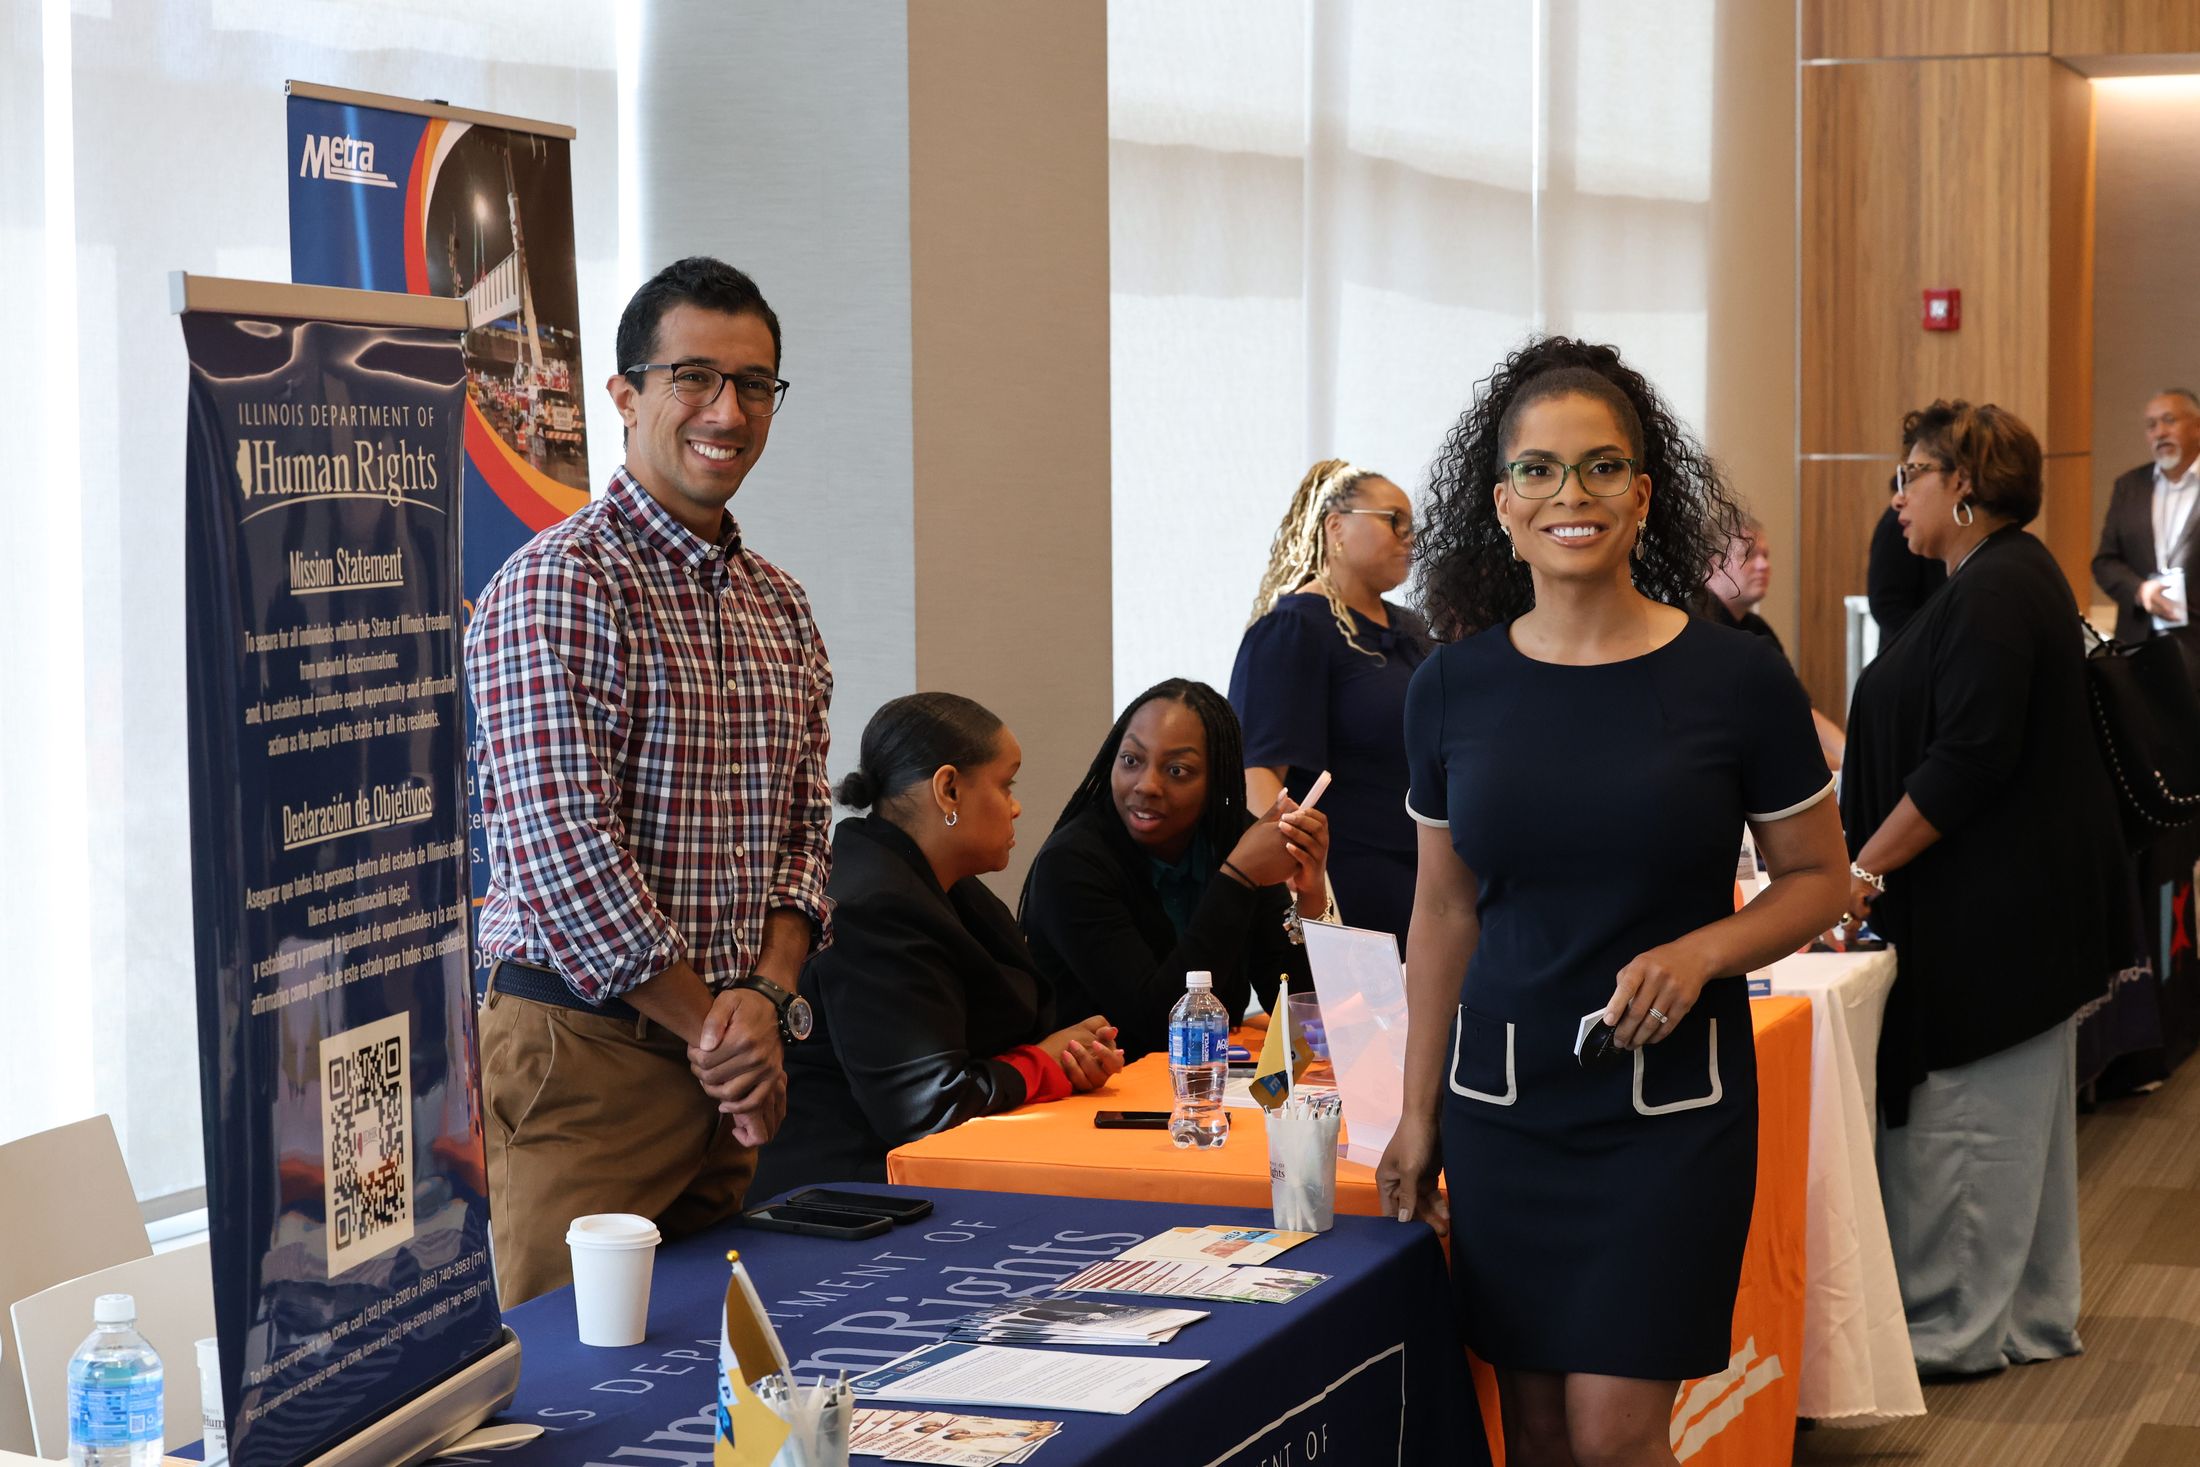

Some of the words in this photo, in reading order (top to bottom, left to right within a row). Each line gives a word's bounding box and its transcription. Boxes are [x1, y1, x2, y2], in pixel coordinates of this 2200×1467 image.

[300, 133, 375, 179] Metra
[238, 402, 304, 426] ILLINOIS
[311, 404, 410, 427] DEPARTMENT
[417, 406, 435, 428] OF
[252, 440, 353, 495] Human
[354, 439, 438, 507] Rights
[289, 550, 334, 589] Mission
[336, 546, 403, 585] Statement
[244, 631, 255, 653] To
[255, 633, 279, 652] secure
[279, 627, 289, 648] for
[290, 625, 299, 648] all
[299, 621, 335, 646] individuals
[335, 619, 357, 641] within
[358, 619, 370, 639] the
[371, 617, 392, 638] State
[392, 615, 400, 635] of
[401, 613, 425, 634] Illinois
[425, 611, 451, 631] freedom
[299, 660, 316, 680] from
[316, 654, 346, 679] unlawful
[263, 702, 271, 722] to
[271, 694, 301, 720] establish
[301, 692, 314, 715] and
[314, 690, 344, 718] promote
[344, 685, 364, 712] equal
[364, 681, 406, 709] opportunity
[406, 678, 420, 699] and
[268, 733, 289, 757] action
[289, 735, 298, 752] as
[298, 728, 309, 750] the
[310, 725, 331, 753] policy
[331, 723, 339, 744] of
[339, 721, 353, 743] this
[354, 719, 373, 740] state
[373, 717, 384, 737] for
[386, 713, 396, 735] all
[396, 713, 407, 733] its
[283, 792, 352, 844] Declaración
[355, 789, 370, 826] de
[373, 781, 432, 825] Objetivos
[246, 887, 280, 911] Asegurar
[281, 881, 294, 904] que
[294, 873, 312, 897] todas
[313, 870, 324, 891] las
[324, 865, 354, 892] personas
[355, 858, 379, 880] dentro
[379, 852, 391, 874] del
[392, 847, 416, 871] estado
[417, 844, 426, 865] de
[426, 840, 449, 863] Illinois
[307, 904, 327, 928] libres
[327, 900, 336, 922] de
[337, 885, 387, 919] discriminación
[251, 987, 290, 1016] afirmativa
[290, 982, 308, 1003] como
[308, 970, 334, 1000] política
[334, 967, 343, 988] de
[343, 963, 359, 984] este
[360, 954, 383, 979] estado
[384, 953, 400, 976] para
[402, 944, 422, 967] todos
[422, 942, 434, 960] sus
[923, 1218, 998, 1243] OF
[250, 1370, 260, 1386] To
[261, 1362, 273, 1381] file
[273, 1361, 279, 1373] a
[280, 1340, 316, 1366] complaint
[316, 1331, 332, 1349] with
[350, 1312, 363, 1331] call
[364, 1300, 380, 1326] (312)
[381, 1287, 412, 1314] 814-6200
[412, 1286, 418, 1298] or
[420, 1270, 438, 1296] (866)
[439, 1258, 470, 1283] 740-3953
[471, 1246, 487, 1270] (TTY)
[246, 1407, 263, 1423] Para
[263, 1388, 293, 1417] presentar
[293, 1381, 307, 1396] una
[307, 1369, 326, 1391] queja
[326, 1362, 341, 1378] ante
[341, 1356, 347, 1369] el
[363, 1340, 380, 1358] llame
[380, 1334, 387, 1347] al
[388, 1323, 402, 1346] (312)
[402, 1310, 427, 1335] 814-6200
[427, 1312, 432, 1320] o
[432, 1298, 449, 1320] (866)
[450, 1285, 476, 1309] 740-3953
[477, 1275, 491, 1297] (TTY)
[1306, 1423, 1328, 1461] OF
